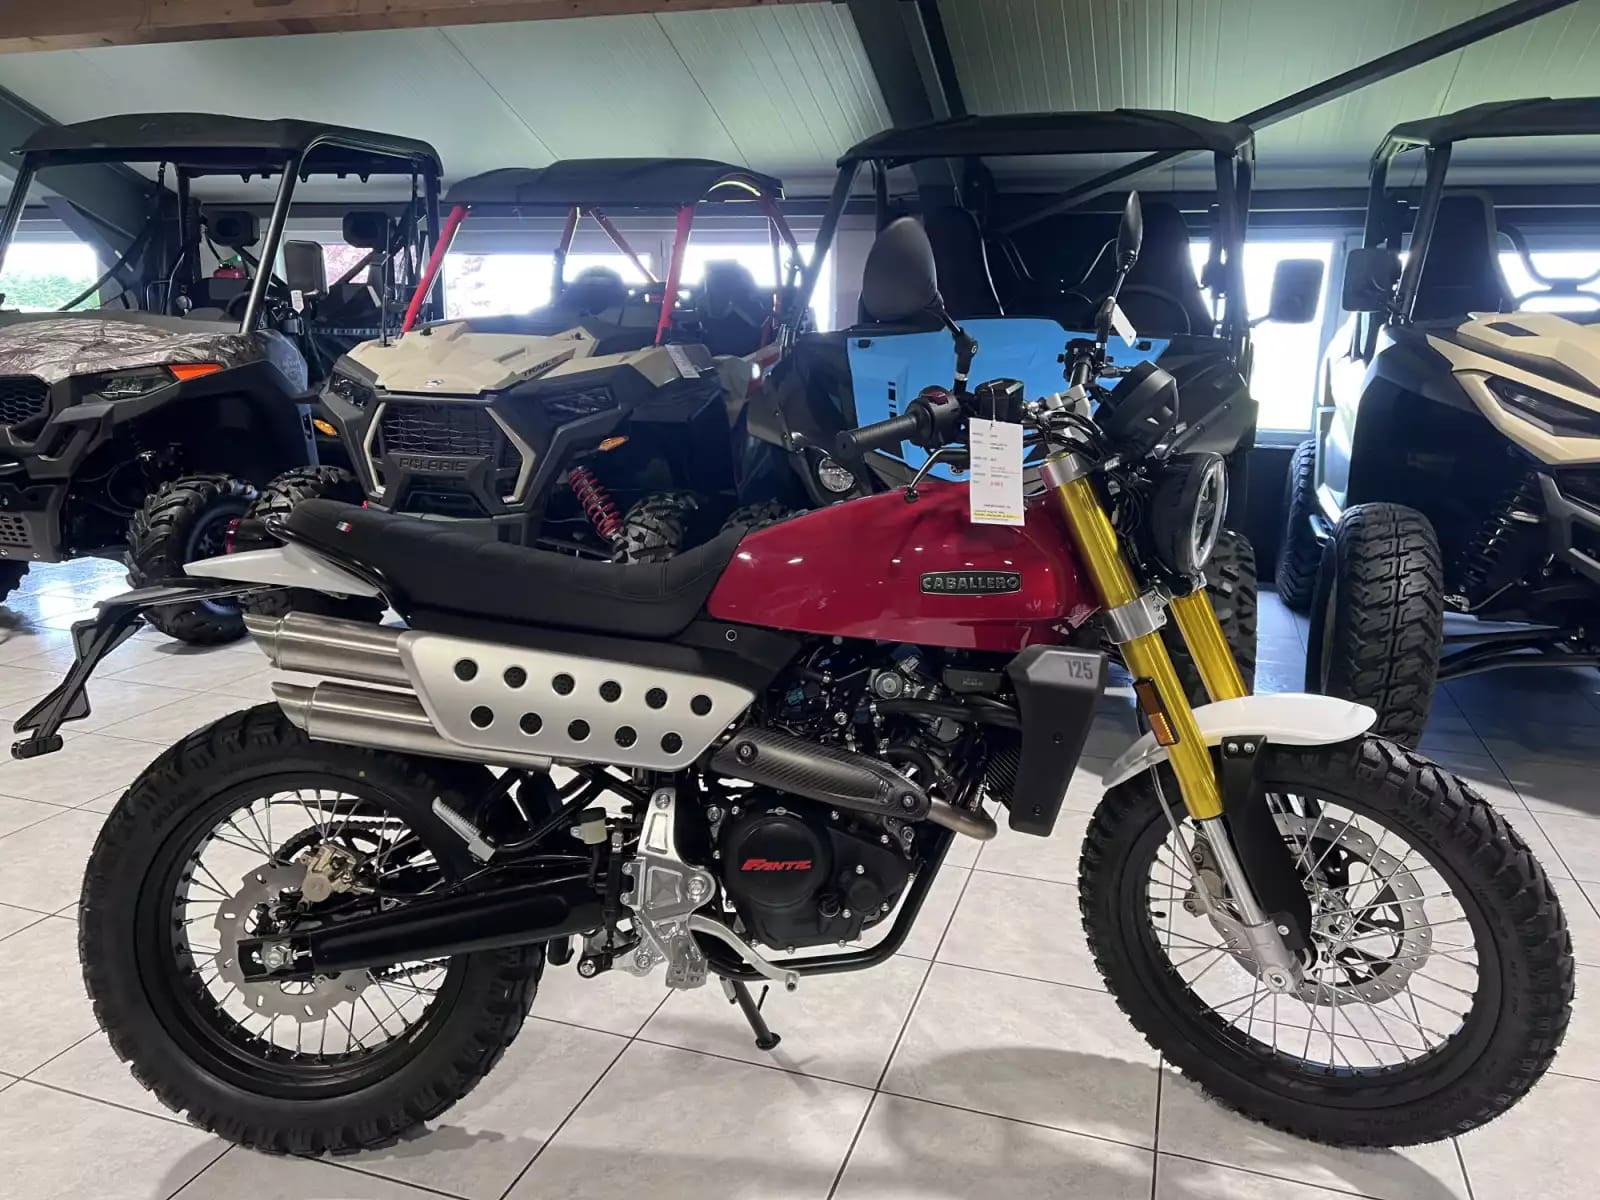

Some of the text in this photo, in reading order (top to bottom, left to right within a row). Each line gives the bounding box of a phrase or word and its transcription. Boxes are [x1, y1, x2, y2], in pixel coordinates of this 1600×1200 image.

[400, 458, 468, 473] POLARIS
[922, 576, 1019, 590] CABALLERO
[1065, 660, 1093, 679] 125
[741, 859, 812, 871] FANTIC
